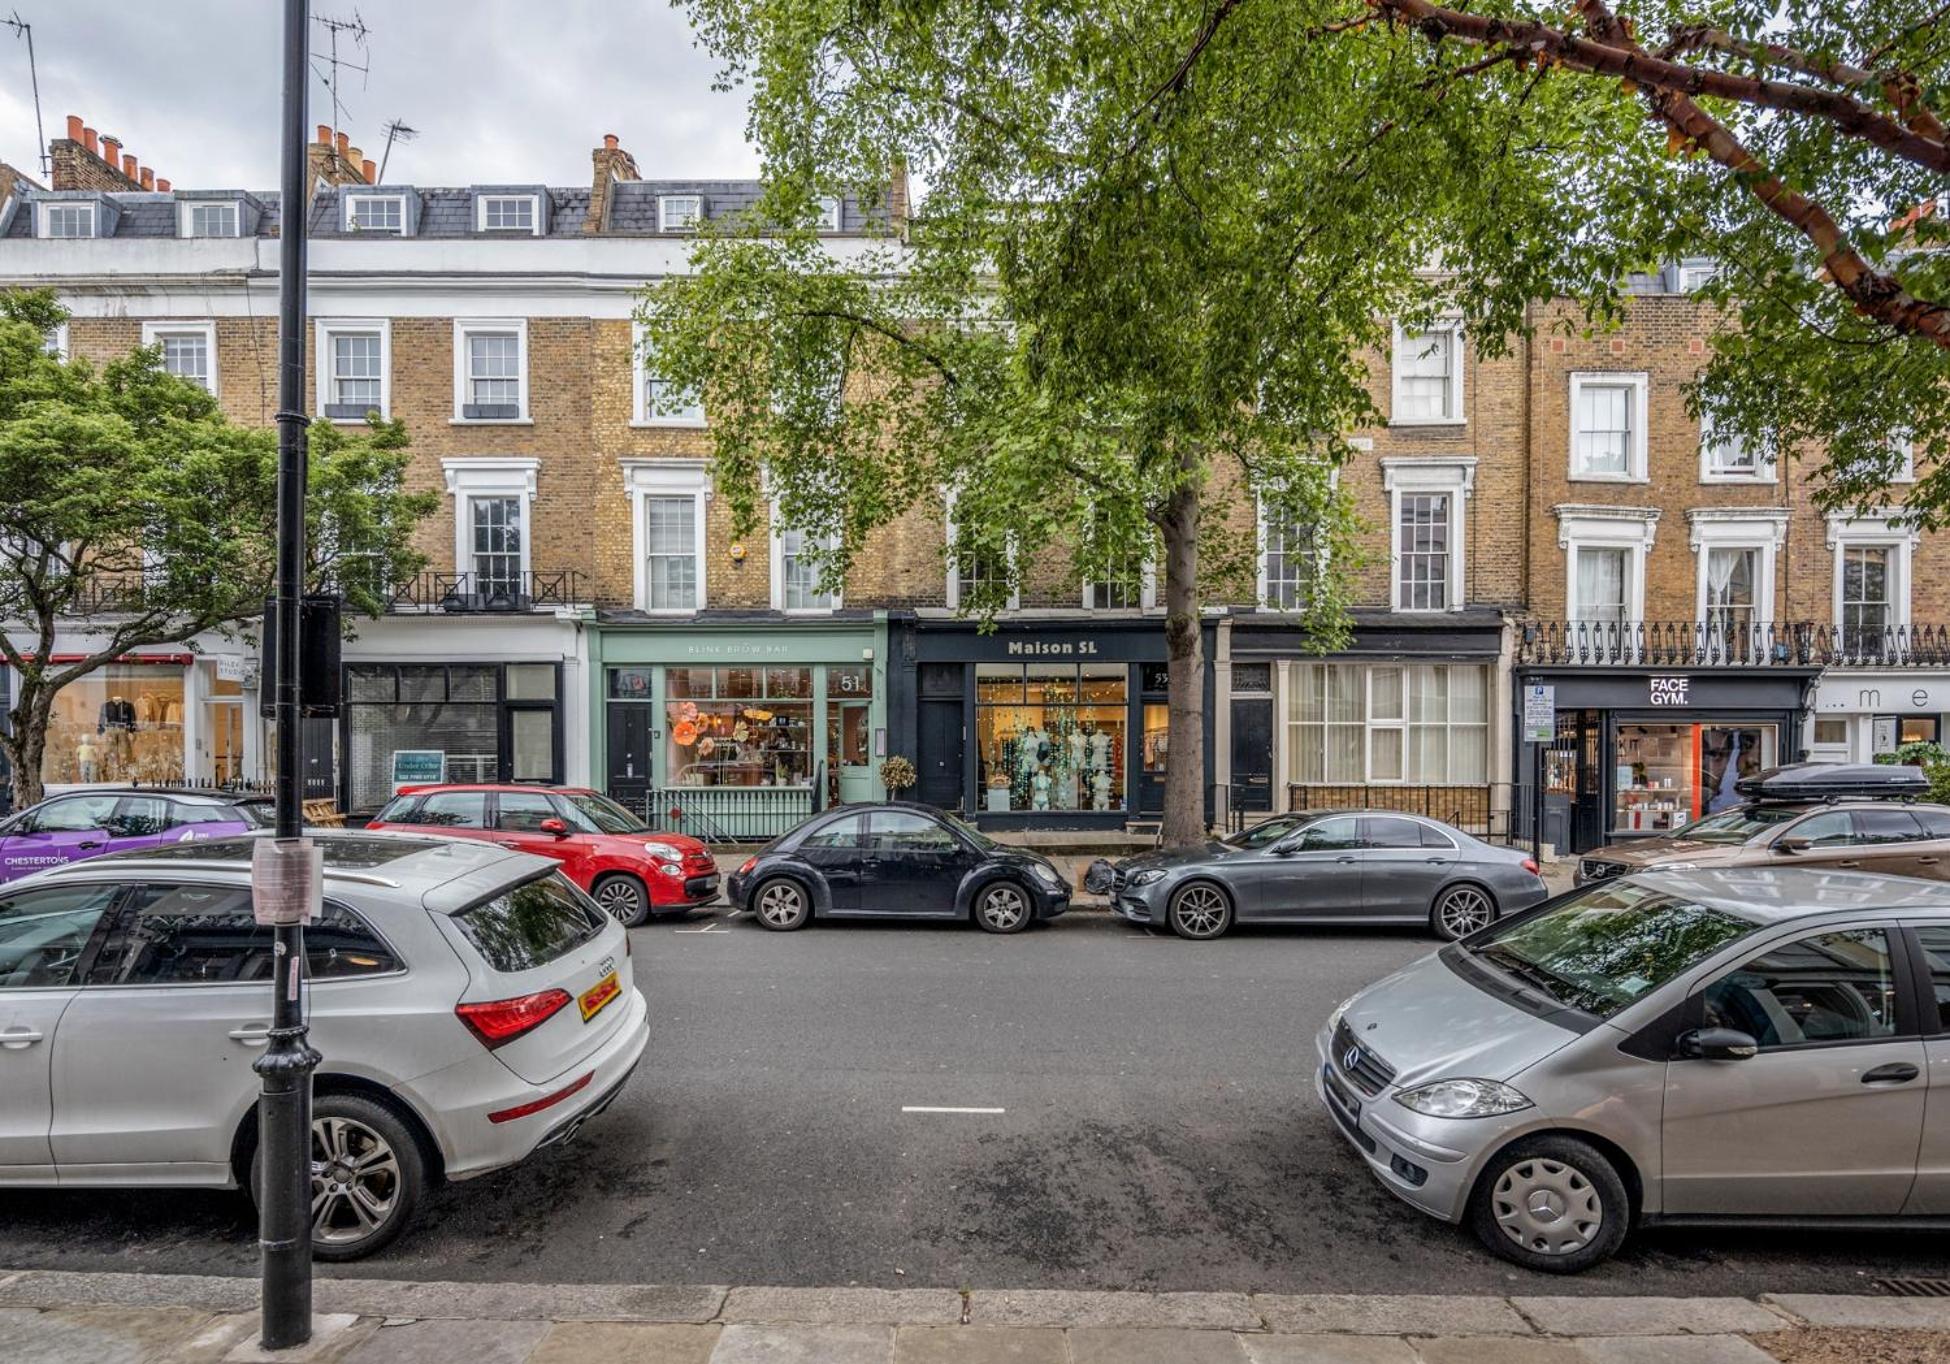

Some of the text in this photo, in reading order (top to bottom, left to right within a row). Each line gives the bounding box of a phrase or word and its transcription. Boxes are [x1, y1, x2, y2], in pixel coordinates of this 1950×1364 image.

[688, 645, 720, 654] BLINK
[766, 645, 788, 654] BAR
[1008, 641, 1098, 654] Maison SL
[841, 676, 859, 691] 51
[1154, 673, 1168, 684] 53
[1650, 679, 1689, 691] FACE
[1650, 691, 1688, 705] GYM.
[4, 856, 70, 865] CHESTERTONS
